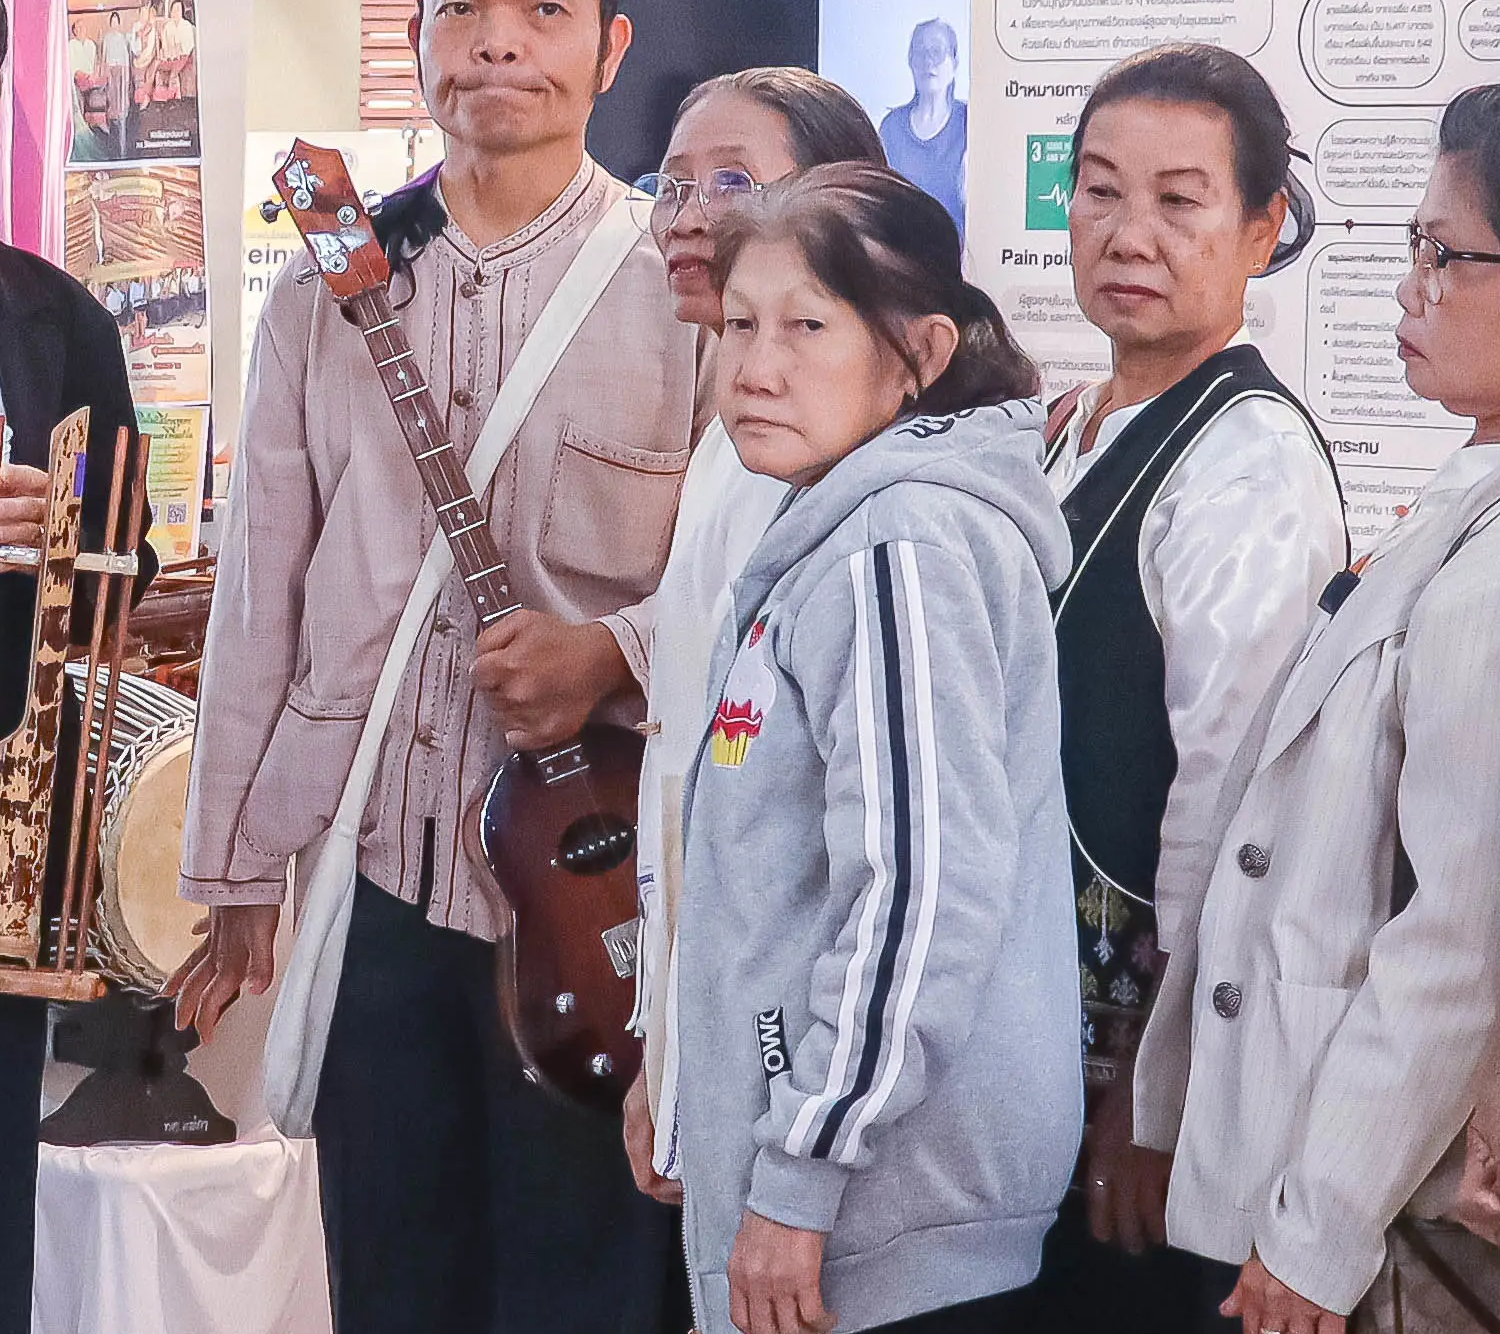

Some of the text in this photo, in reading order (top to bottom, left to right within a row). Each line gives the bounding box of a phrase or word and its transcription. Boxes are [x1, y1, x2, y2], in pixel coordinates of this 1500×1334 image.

[1030, 140, 1042, 163] 3
[243, 243, 294, 264] ein
[1001, 248, 1039, 267] Pain
